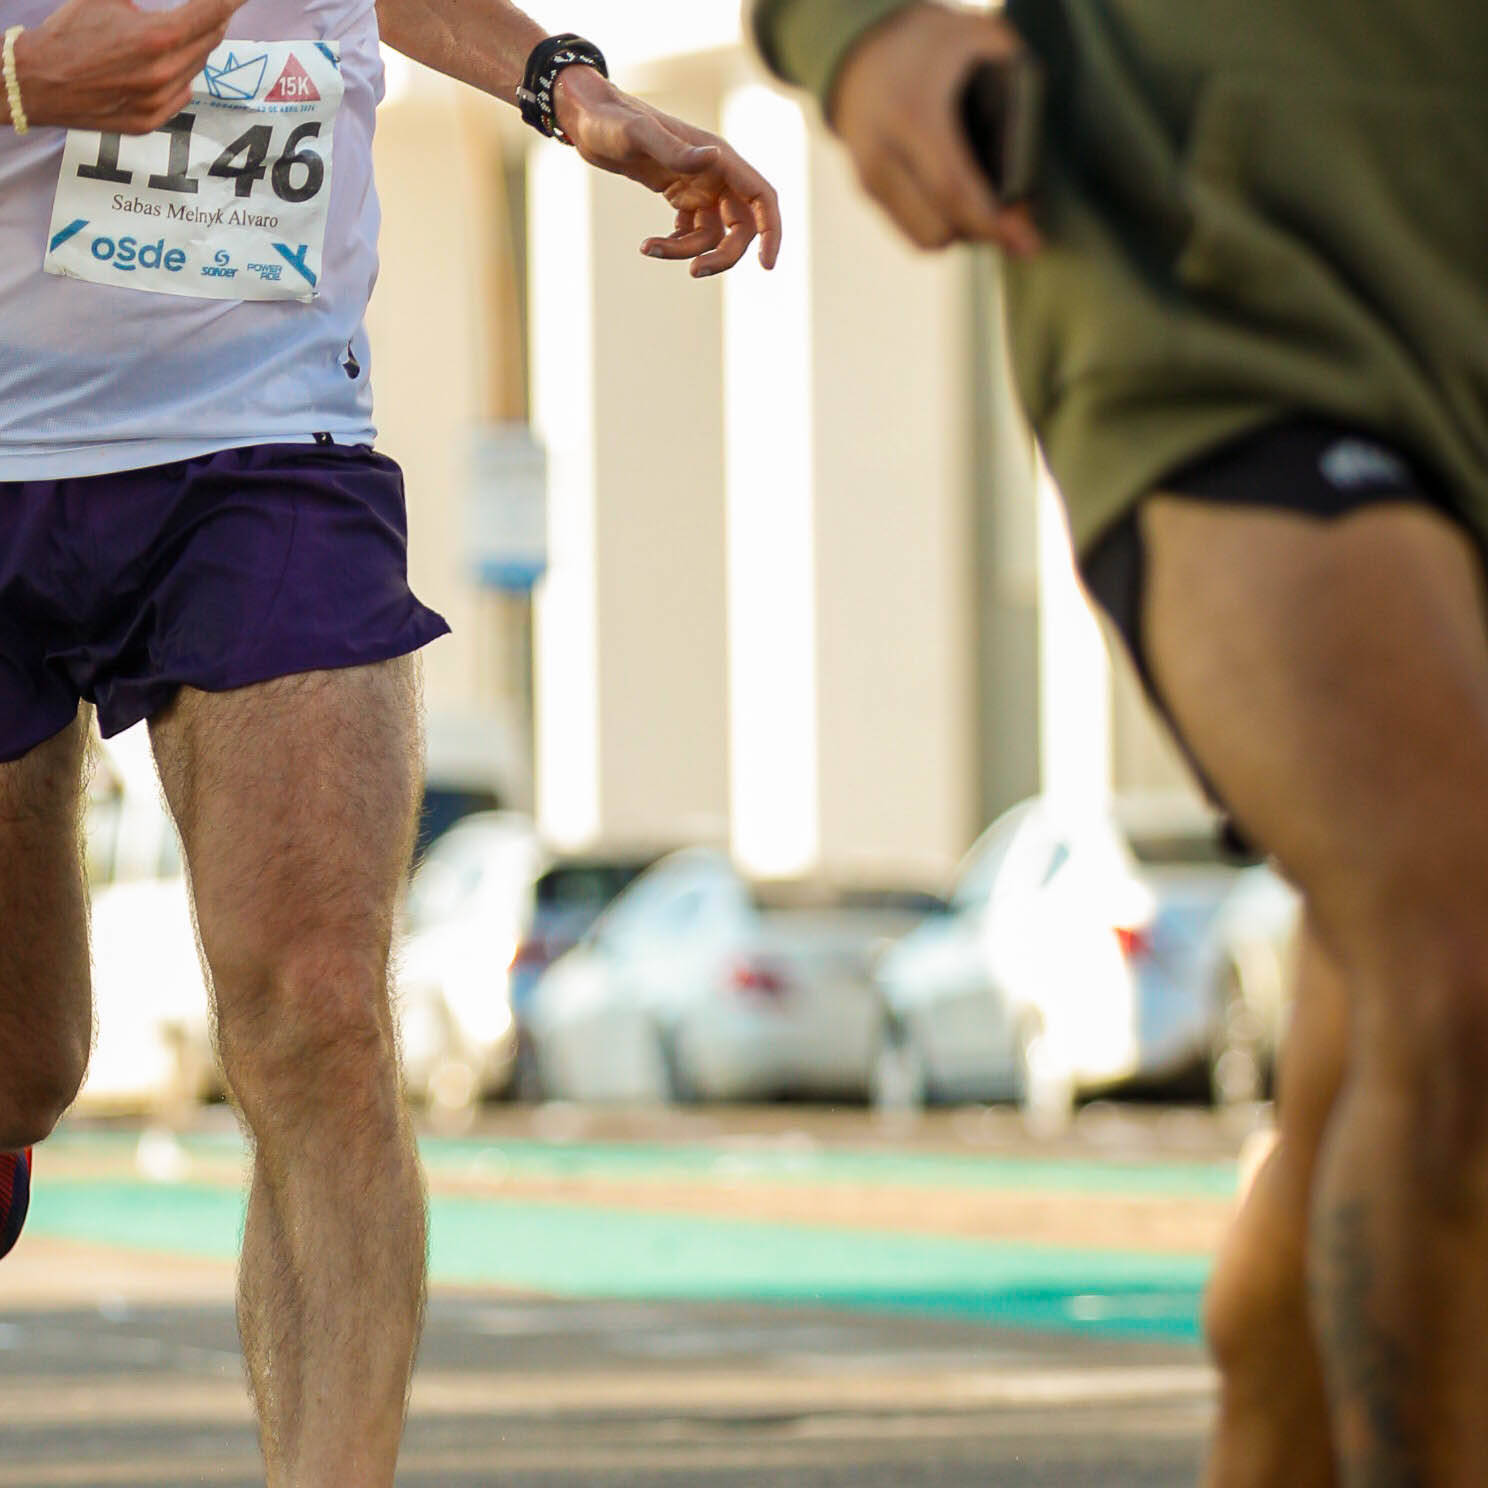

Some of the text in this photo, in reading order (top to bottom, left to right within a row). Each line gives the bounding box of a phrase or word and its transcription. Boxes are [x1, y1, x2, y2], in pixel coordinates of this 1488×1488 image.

[278, 76, 310, 96] 15K
[76, 112, 324, 203] 1146
[112, 194, 279, 229] Sabas Melnyk Alvaro
[90, 236, 186, 272] osde
